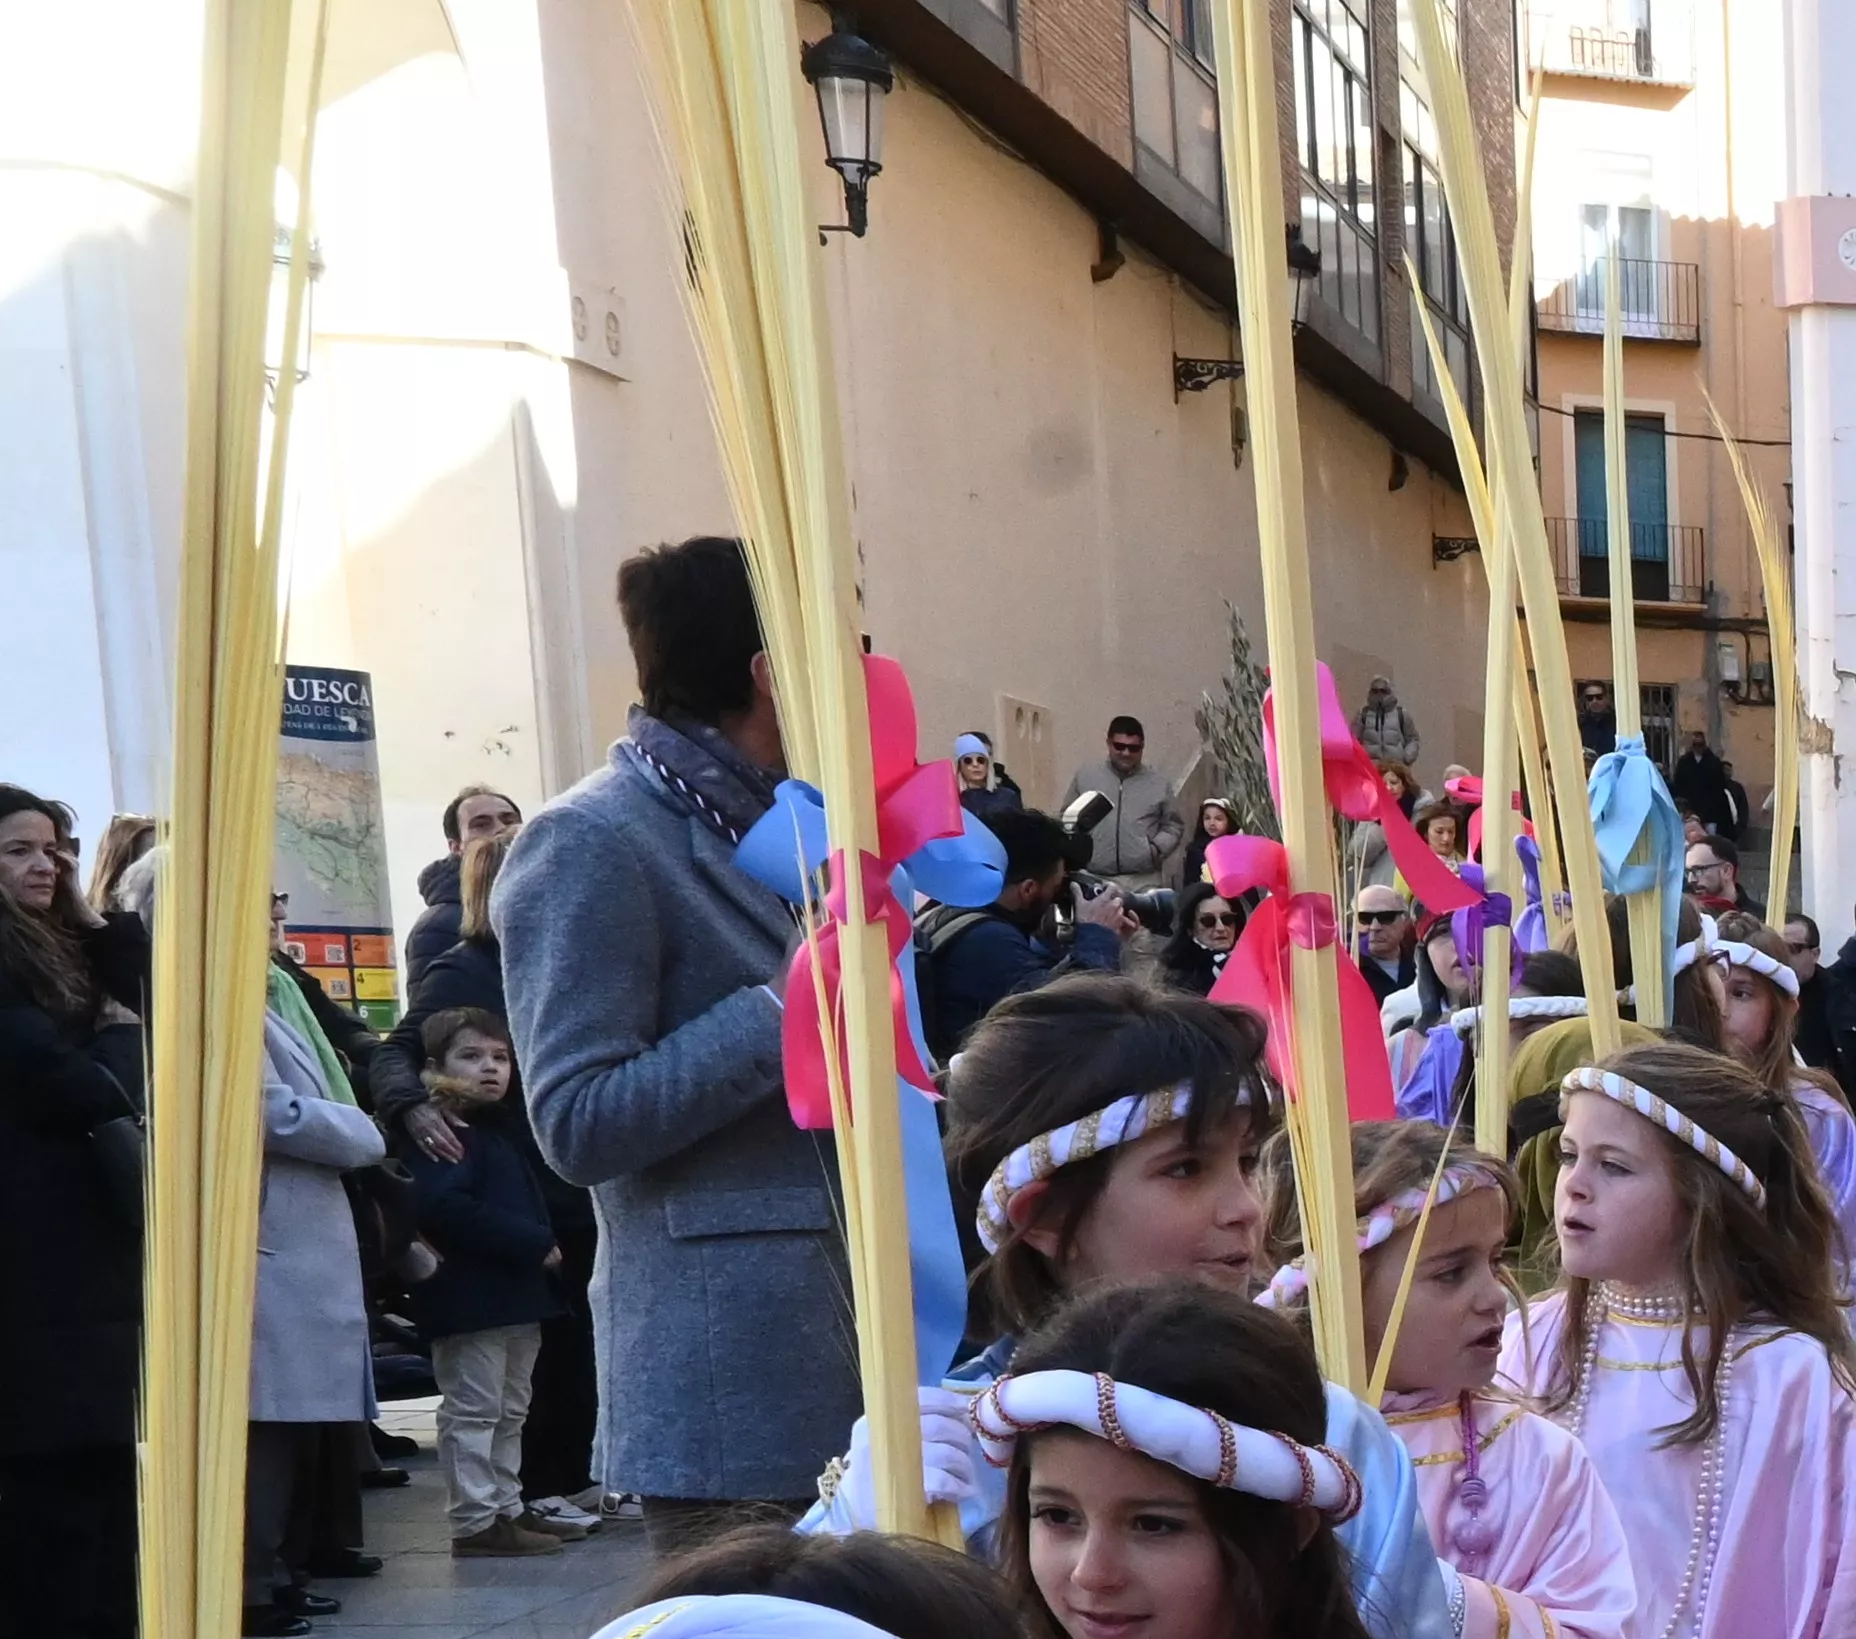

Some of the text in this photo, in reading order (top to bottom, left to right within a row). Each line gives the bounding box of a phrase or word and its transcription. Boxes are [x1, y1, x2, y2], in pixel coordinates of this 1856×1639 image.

[285, 677, 370, 707] UESCA
[283, 703, 312, 716] DAD
[314, 705, 332, 718] DE
